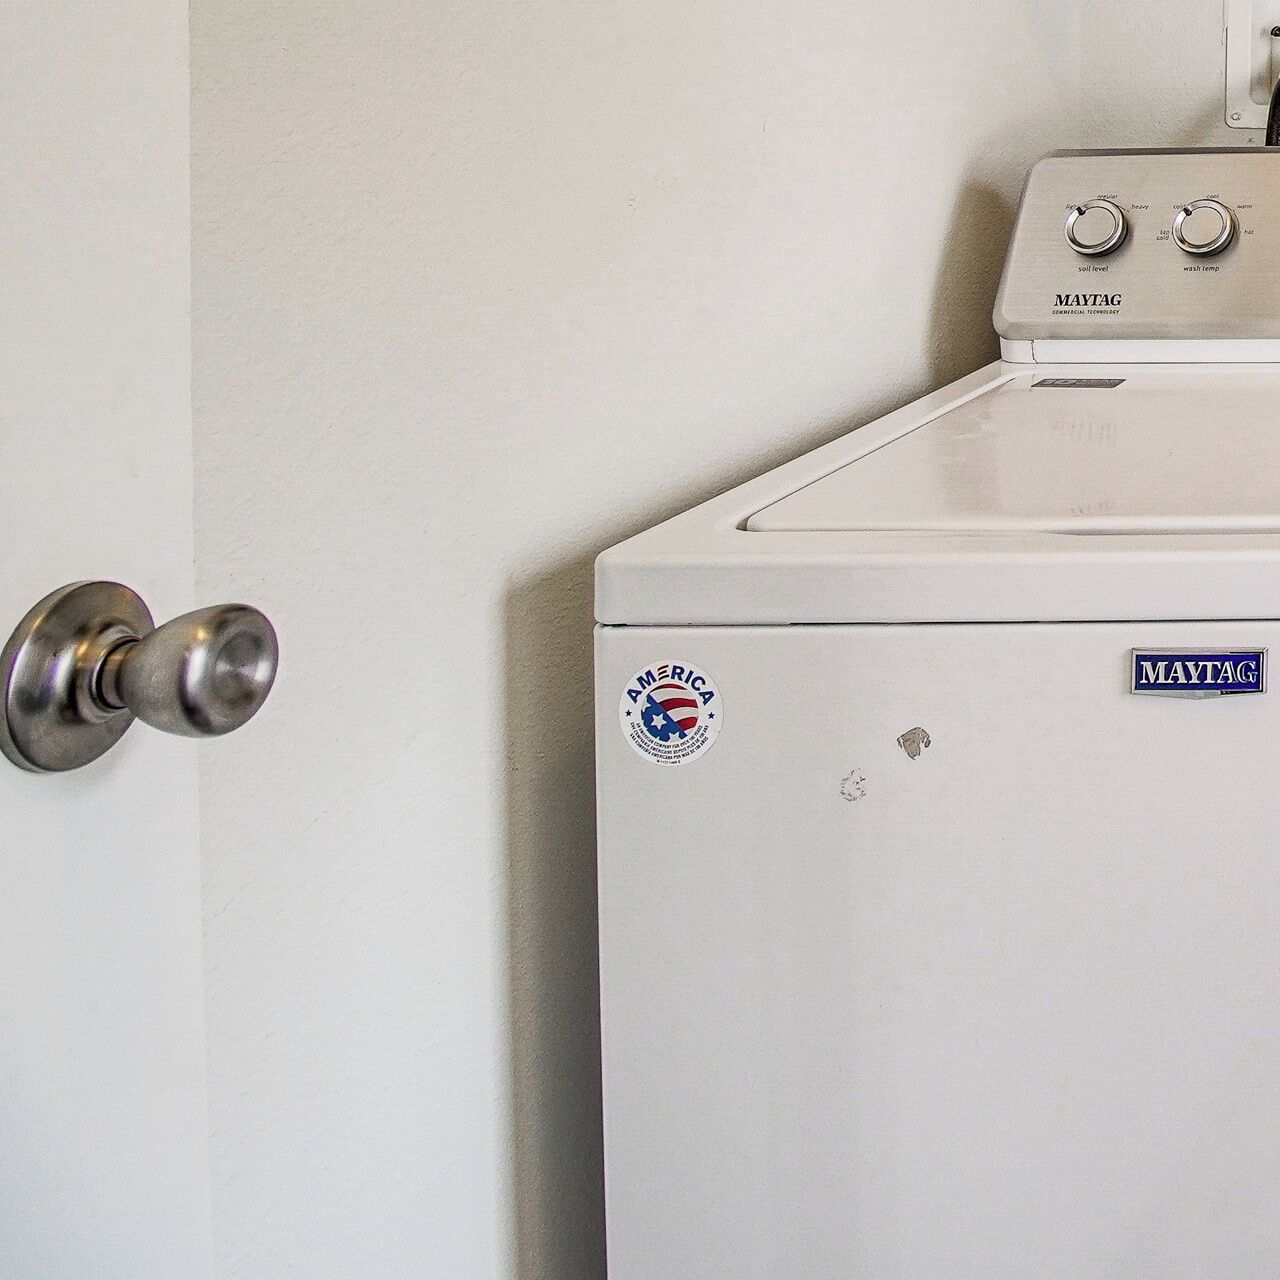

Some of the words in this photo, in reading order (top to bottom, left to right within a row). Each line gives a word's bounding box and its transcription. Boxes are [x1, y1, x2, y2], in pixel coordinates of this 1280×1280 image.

[1053, 293, 1122, 307] MAYTAG
[1140, 660, 1258, 684] MAYTAG
[626, 664, 715, 706] AMERICA
